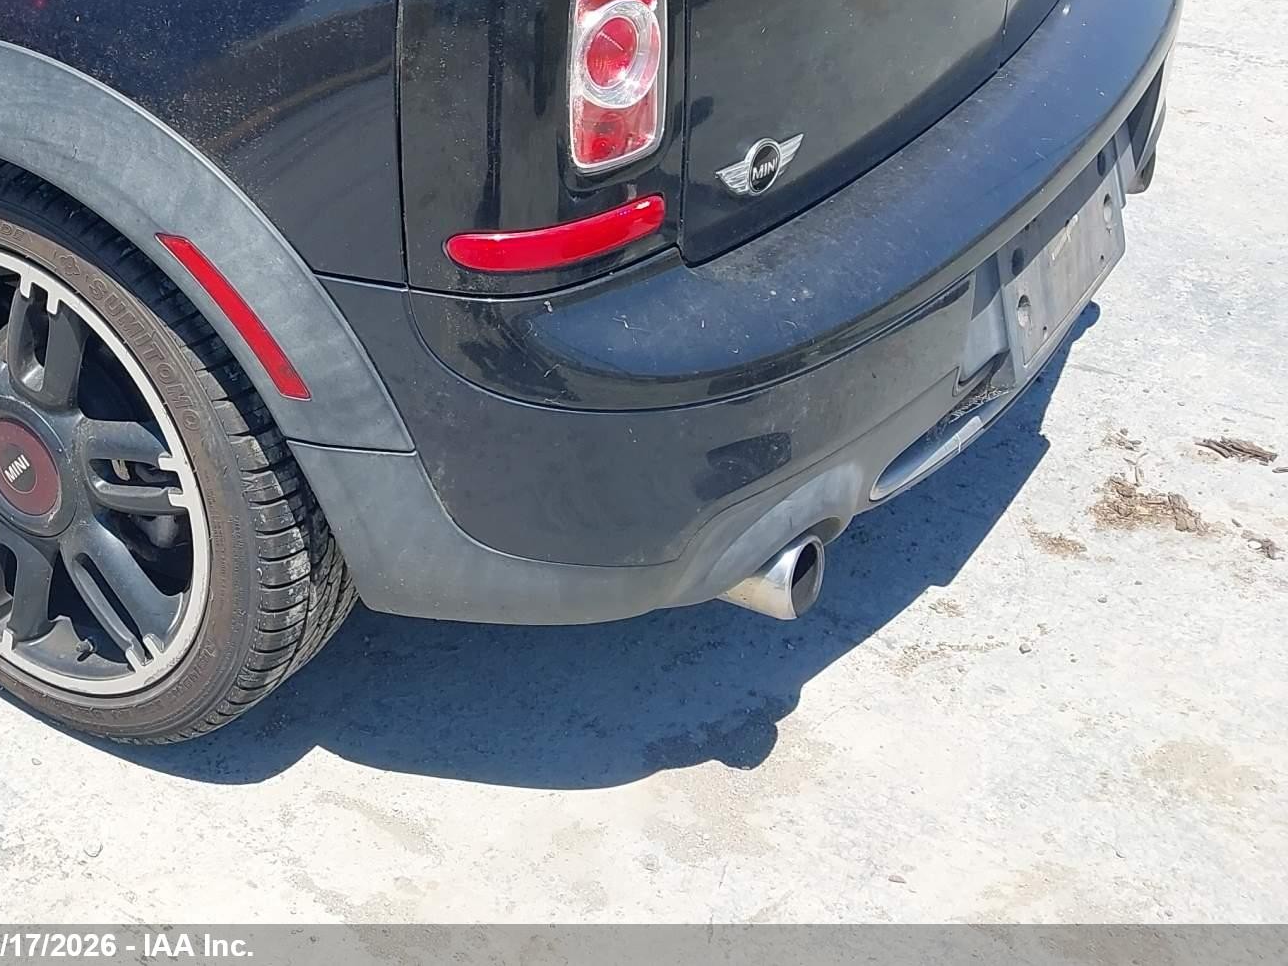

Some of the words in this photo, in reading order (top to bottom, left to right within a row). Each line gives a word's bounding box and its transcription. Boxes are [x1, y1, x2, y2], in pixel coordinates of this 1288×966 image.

[752, 156, 779, 181] MINI
[88, 277, 202, 432] SUMITOMO
[3, 453, 31, 484] MINI
